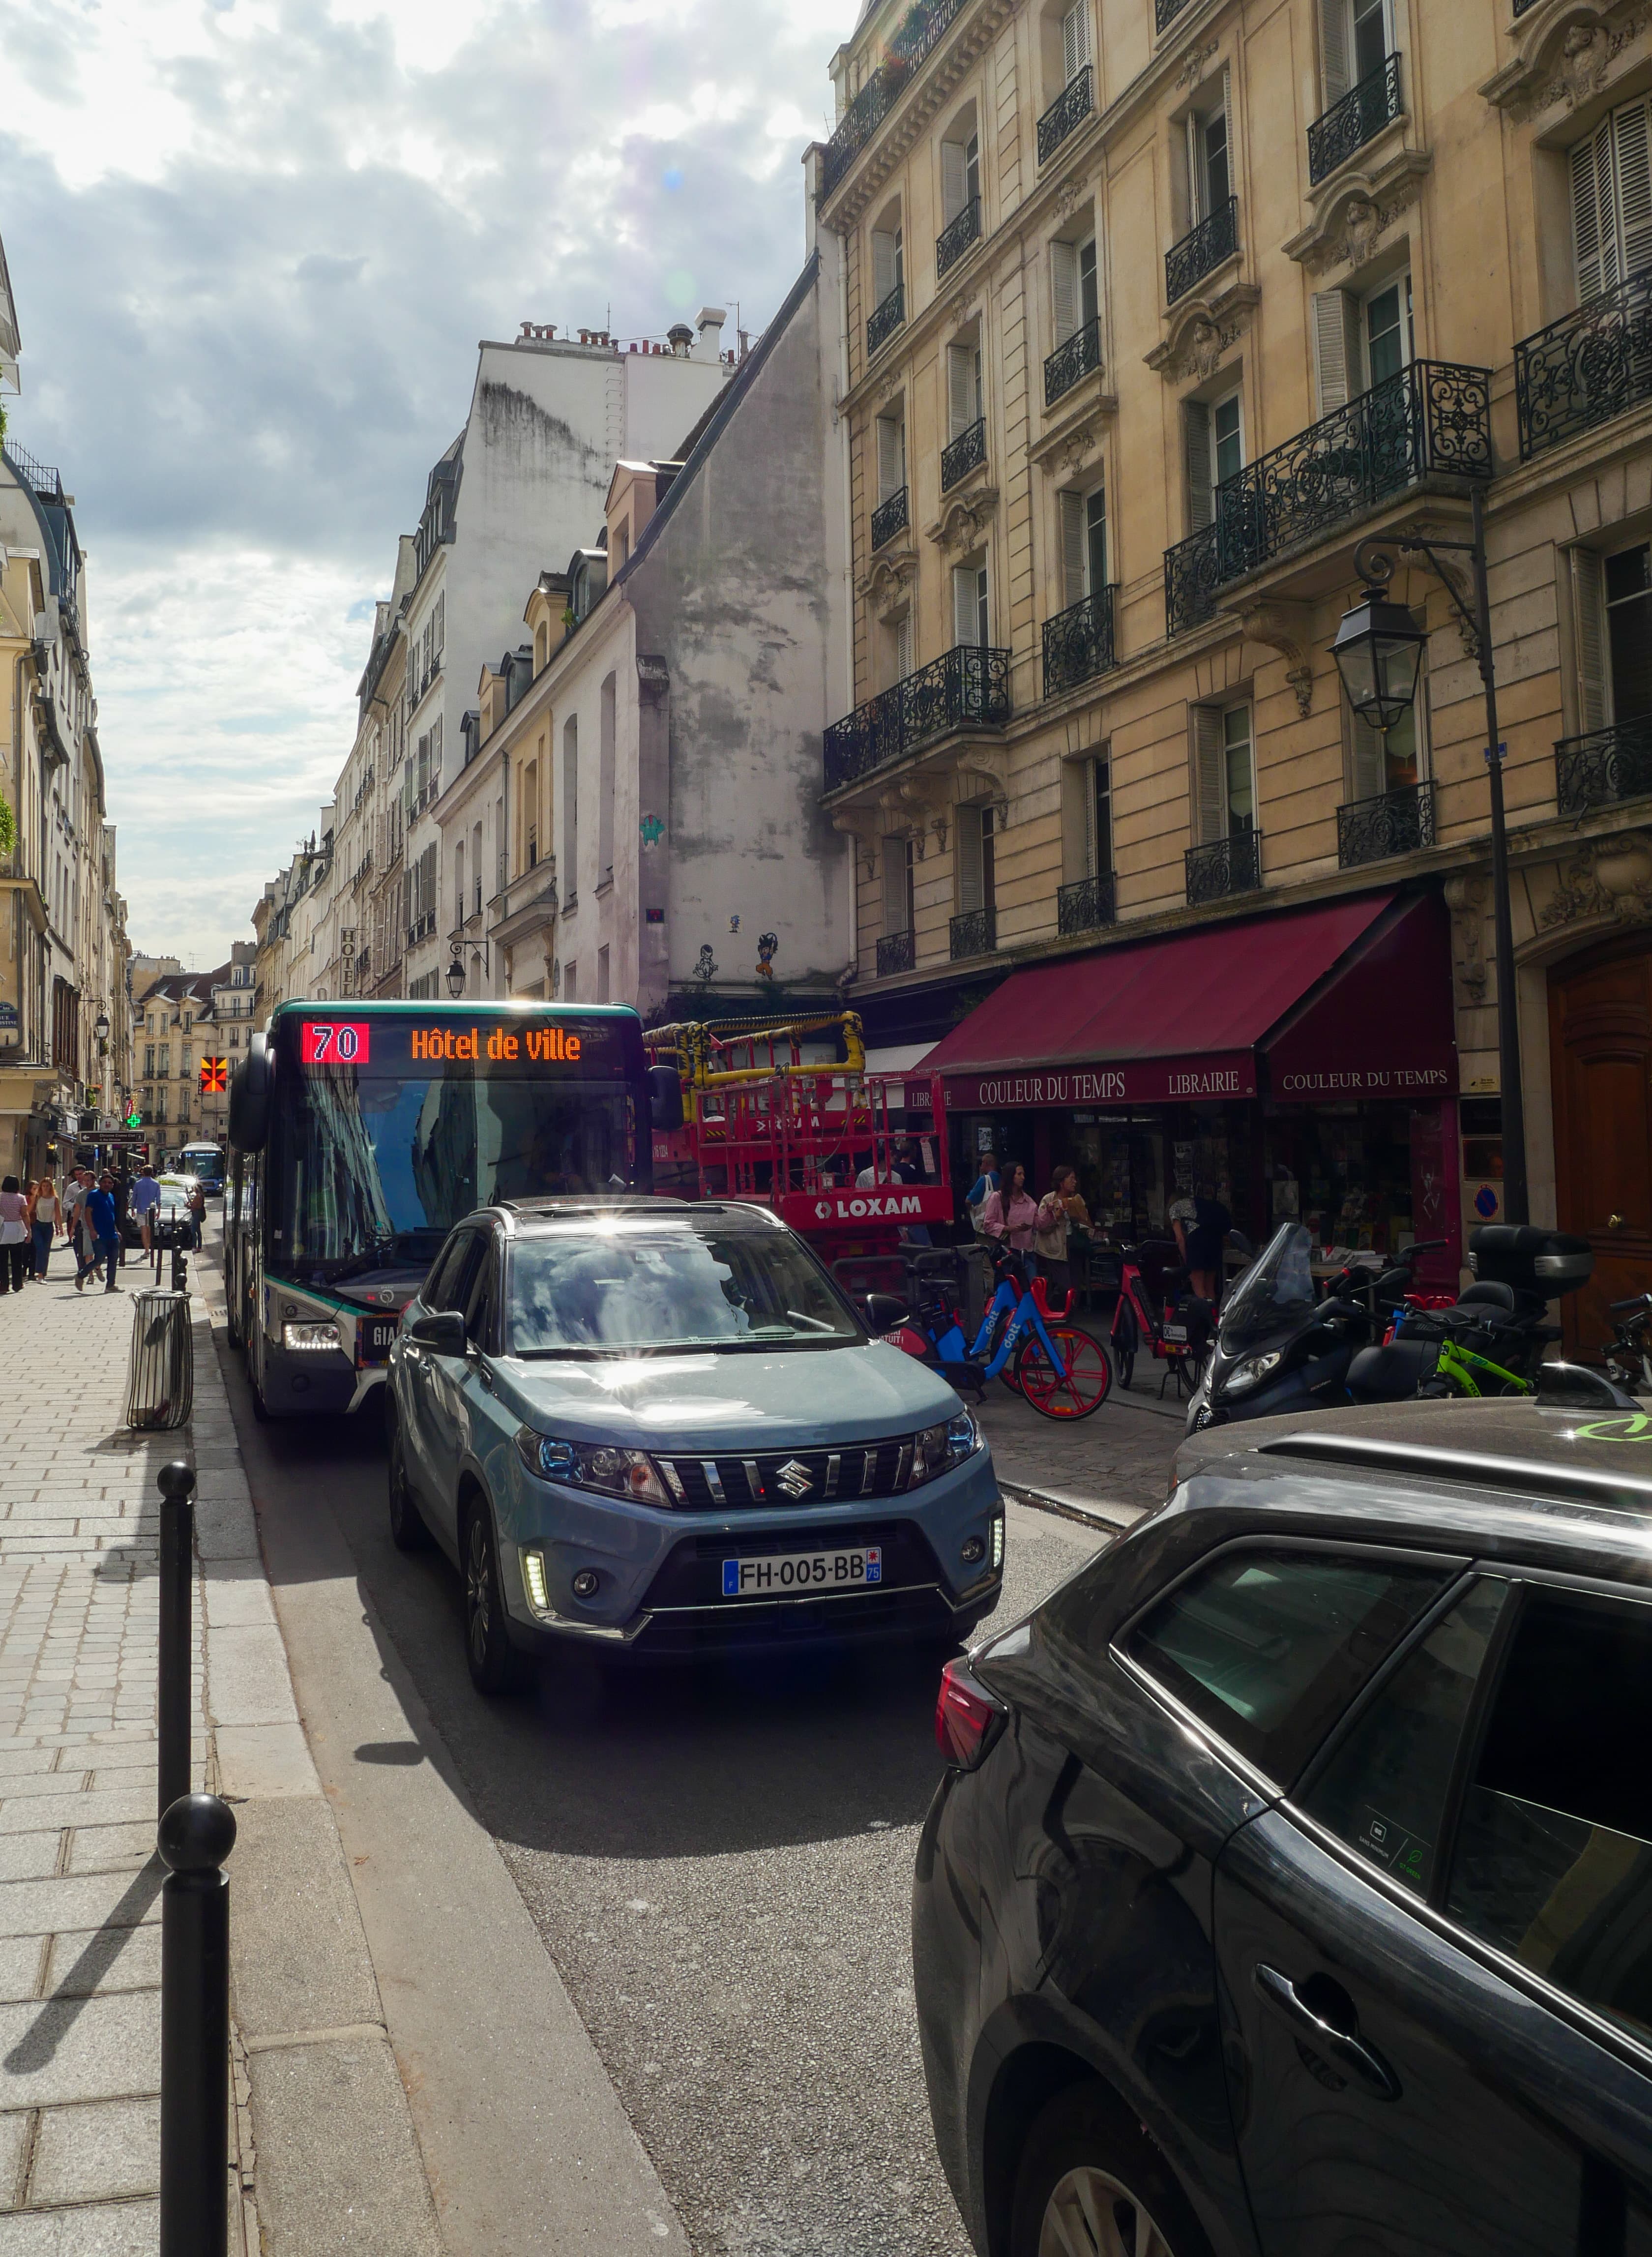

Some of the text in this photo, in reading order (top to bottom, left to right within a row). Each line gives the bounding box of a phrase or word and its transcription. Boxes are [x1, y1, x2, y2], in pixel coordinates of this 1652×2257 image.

[342, 930, 354, 996] HOTEL
[313, 1026, 358, 1060] 70
[412, 1028, 581, 1060] Hôtel de Ville
[979, 1072, 1125, 1104] COULEUR DU TEMPS
[1168, 1071, 1239, 1094] LIBRAIRIE
[1283, 1069, 1448, 1090] COULEUR DU TEMPS
[912, 1091, 951, 1106] LIBRIE
[837, 1196, 922, 1218] LOXAM
[985, 1310, 1000, 1334] dott
[374, 1326, 399, 1345] GIA
[1004, 1323, 1021, 1348] dott
[740, 1554, 864, 1589] FH-005-BB
[867, 1567, 879, 1579] 75
